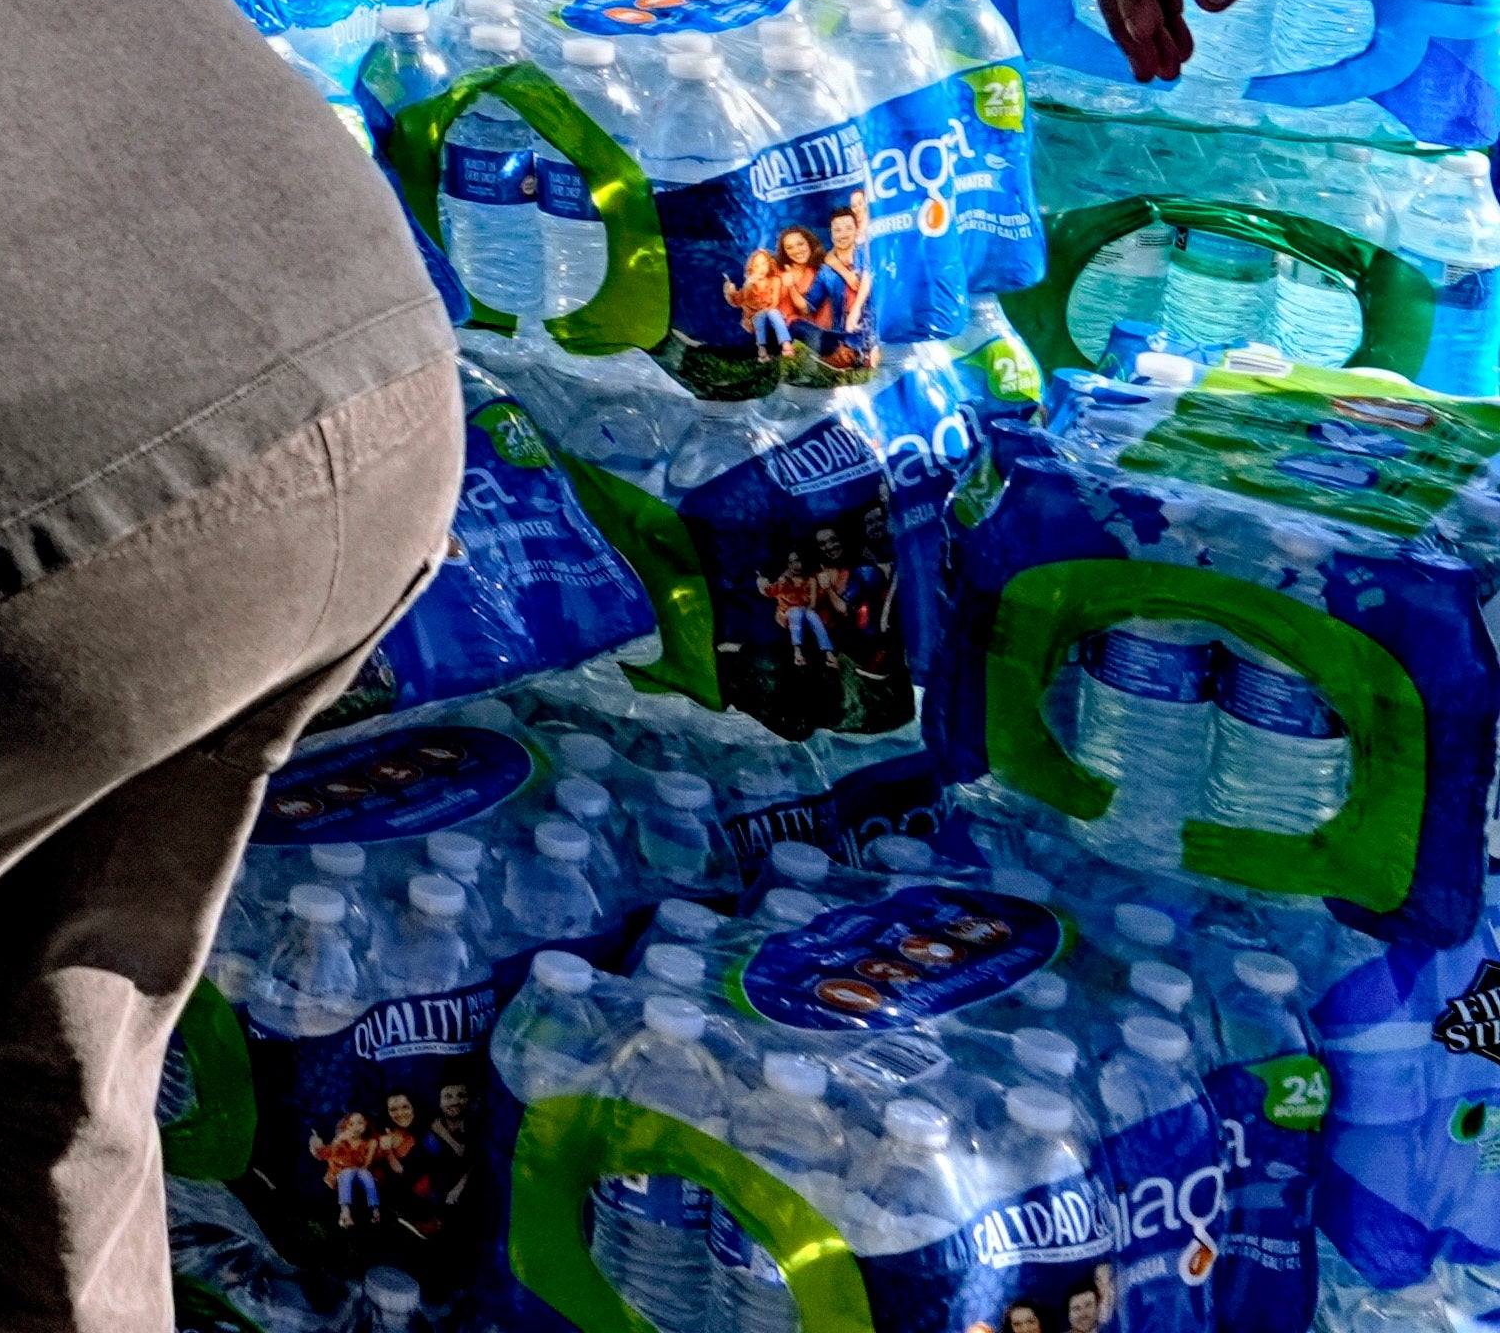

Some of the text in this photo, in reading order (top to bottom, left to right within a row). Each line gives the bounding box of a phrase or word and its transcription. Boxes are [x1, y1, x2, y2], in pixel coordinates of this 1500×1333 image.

[982, 82, 1021, 107] 24
[751, 135, 845, 203] QUALITY
[954, 172, 993, 192] WATER
[354, 997, 465, 1061] QUALITY
[1281, 1075, 1326, 1103] 24
[974, 1191, 1096, 1265] CALIDAD
